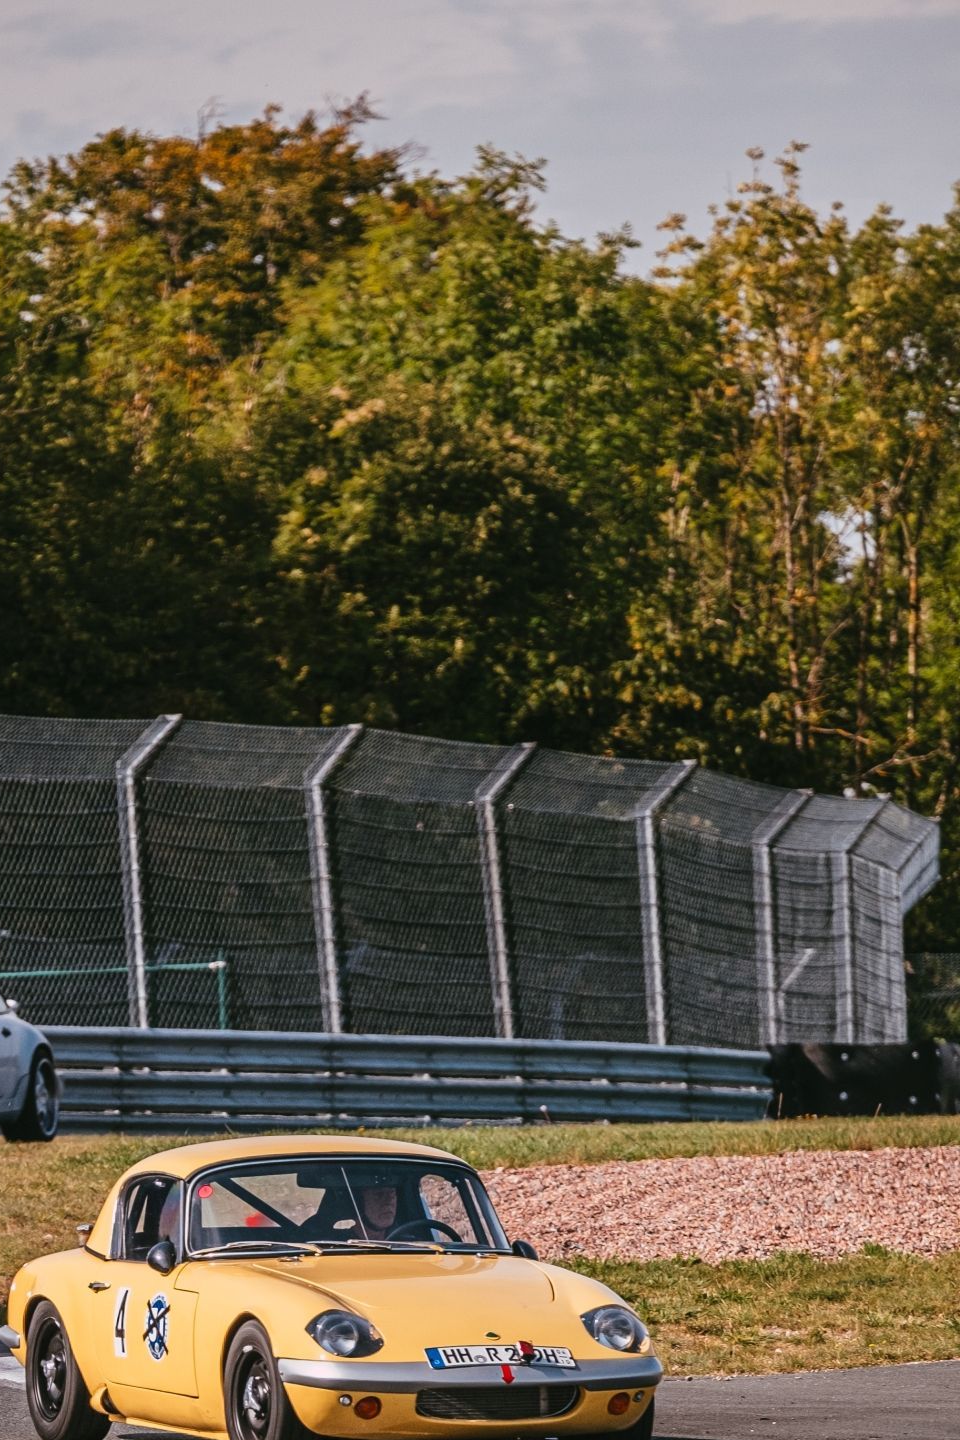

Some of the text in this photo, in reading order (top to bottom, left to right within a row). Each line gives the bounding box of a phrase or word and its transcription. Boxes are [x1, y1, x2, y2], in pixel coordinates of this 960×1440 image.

[115, 1289, 129, 1354] 4
[442, 1348, 474, 1364] HH
[485, 1347, 503, 1363] R
